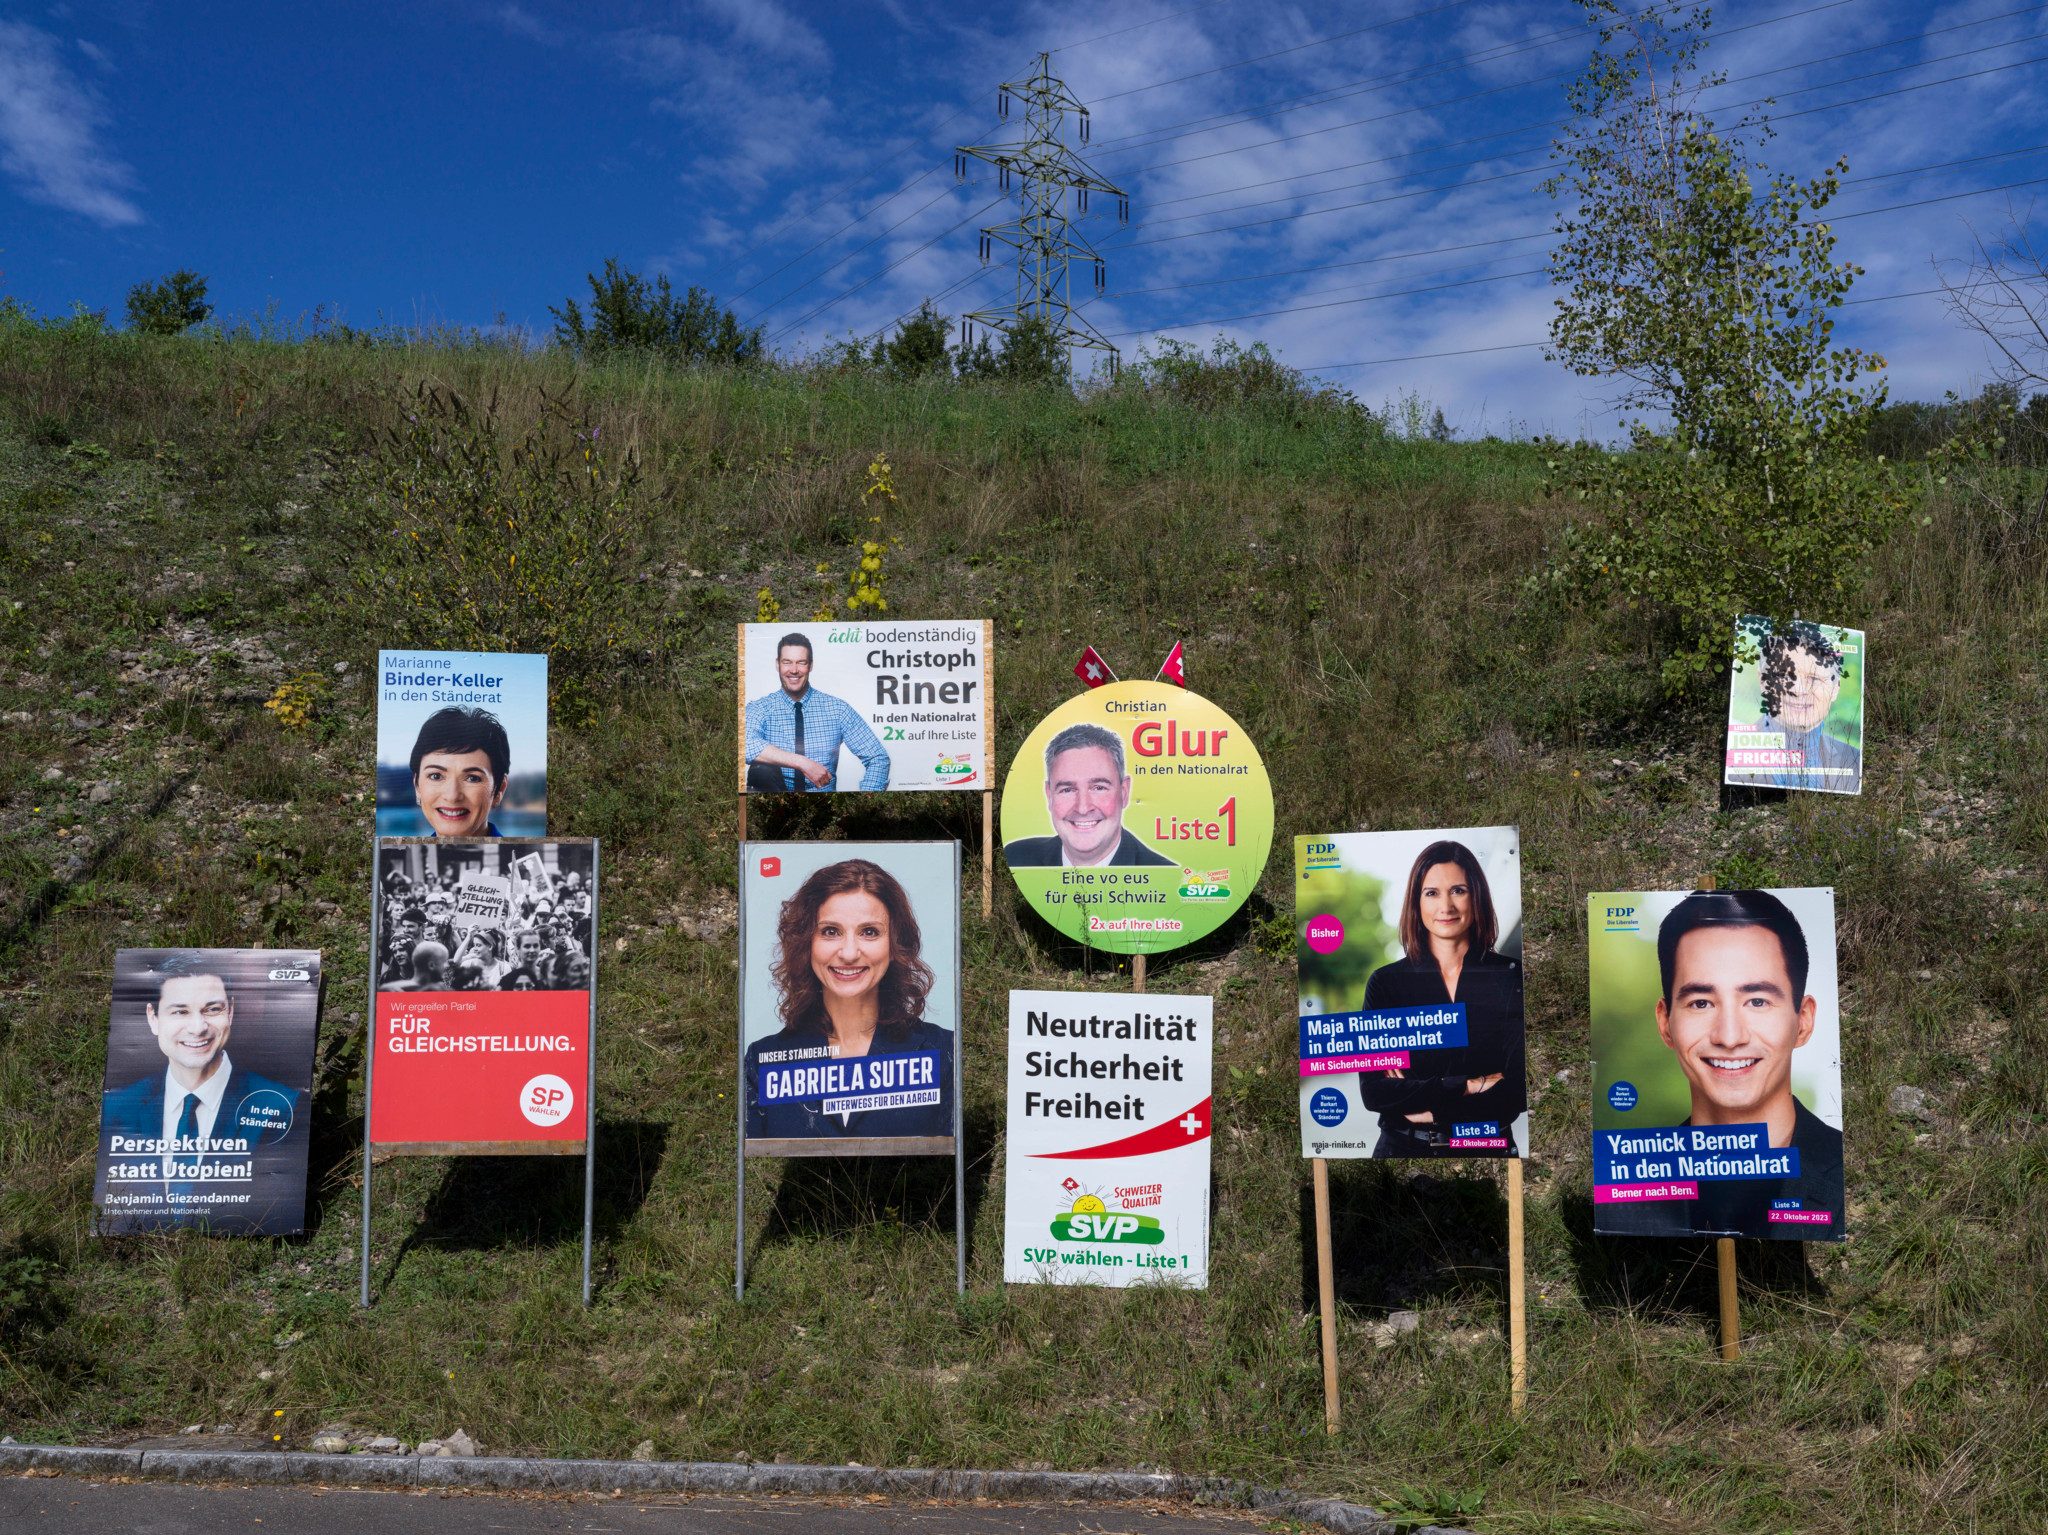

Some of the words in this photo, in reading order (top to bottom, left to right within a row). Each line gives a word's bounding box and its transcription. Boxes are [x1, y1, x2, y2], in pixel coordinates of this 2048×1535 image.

[828, 628, 863, 644] ächt
[866, 628, 976, 644] bodenständig
[385, 656, 450, 668] Marianne
[866, 648, 976, 672] Christoph
[384, 672, 504, 688] Binder-Keller
[384, 690, 400, 701] in
[401, 690, 428, 702] den
[432, 690, 502, 703] Ständerat
[876, 674, 976, 705] Riner
[1106, 700, 1166, 712] Christian
[873, 714, 884, 722] In
[886, 713, 908, 722] den
[911, 712, 976, 722] Nationalrat
[883, 726, 905, 740] 2x
[908, 730, 925, 740] auf
[928, 730, 948, 740] Ihre
[952, 730, 976, 740] Liste
[1132, 720, 1228, 757] Glur
[1733, 735, 1784, 748] JONAS
[1734, 752, 1802, 764] FRICKER
[940, 764, 964, 772] SVP
[1135, 765, 1146, 774] in
[1151, 764, 1173, 774] den
[1178, 764, 1248, 774] Nationalrat
[1156, 817, 1220, 840] Liste
[1218, 796, 1236, 846] 1
[1306, 844, 1336, 854] FDP
[1062, 872, 1094, 884] Eine
[1100, 874, 1118, 884] vo
[1124, 874, 1149, 884] eus
[468, 884, 500, 895] GLEICH-
[1187, 885, 1218, 896] SVP
[462, 893, 504, 905] STELLUNG
[1045, 891, 1068, 904] für
[1073, 891, 1103, 904] eusi
[1108, 890, 1166, 904] Schwiiz
[458, 904, 499, 918] JETZT!
[1606, 908, 1635, 917] FDP
[1090, 918, 1106, 930] 2x
[1108, 920, 1126, 930] auf
[1130, 920, 1152, 930] Ihre
[1156, 920, 1181, 930] Liste
[1311, 928, 1340, 938] Bisher
[275, 971, 301, 979] SVP
[390, 1002, 406, 1011] Wir
[408, 1002, 448, 1012] ergreifen
[450, 1002, 476, 1010] Partei
[390, 1014, 430, 1034] FÜR
[1027, 1012, 1196, 1041] Neutralität
[1308, 1020, 1344, 1038] Maja
[1349, 1014, 1402, 1032] Riniker
[1406, 1010, 1458, 1027] wieder
[389, 1036, 576, 1052] GLEICHSTELLUNG.
[1308, 1040, 1322, 1054] in
[1326, 1036, 1354, 1053] den
[1358, 1030, 1442, 1050] Nationalrat
[758, 1051, 788, 1064] UNSERE
[1310, 1062, 1326, 1072] Mit
[1328, 1059, 1371, 1070] Sicherheit
[1374, 1057, 1404, 1068] richtig.
[1026, 1051, 1183, 1082] Sicherheit
[766, 1063, 864, 1099] GABRIELA
[870, 1056, 934, 1089] SUTER
[531, 1087, 564, 1106] SP
[826, 1097, 872, 1112] UNTERWEGS
[890, 1094, 905, 1106] DEN
[906, 1091, 938, 1104] AARGAU
[250, 1106, 260, 1116] In
[262, 1107, 280, 1116] den
[529, 1106, 560, 1117] WÄHLEN
[1026, 1092, 1144, 1120] Freiheit
[240, 1117, 287, 1130] Ständerat
[1456, 1125, 1480, 1137] Liste
[1484, 1124, 1496, 1135] 3a
[110, 1135, 248, 1155] Perspektiven
[1312, 1140, 1366, 1151] maja-riniker.ch
[1608, 1132, 1686, 1154] Yannick
[1692, 1130, 1758, 1150] Berner
[108, 1162, 156, 1178] statt
[162, 1161, 252, 1180] Utopien!
[1610, 1160, 1628, 1180] in
[1636, 1158, 1672, 1178] den
[1679, 1154, 1790, 1176] Nationalrat
[1114, 1184, 1162, 1198] SCHWEIZER
[1612, 1188, 1642, 1198] Berner
[1646, 1186, 1668, 1196] nach
[1670, 1185, 1694, 1196] Bern.
[105, 1194, 162, 1206] Benjamin
[166, 1193, 251, 1204] Giezendanner
[1122, 1194, 1162, 1209] QUALITÄT
[1784, 1213, 1810, 1221] Oktober
[1068, 1214, 1138, 1240] SVP
[1024, 1248, 1056, 1263] SVP
[1061, 1250, 1123, 1266] wählen
[1136, 1253, 1177, 1268] Liste
[1182, 1255, 1188, 1268] 1
